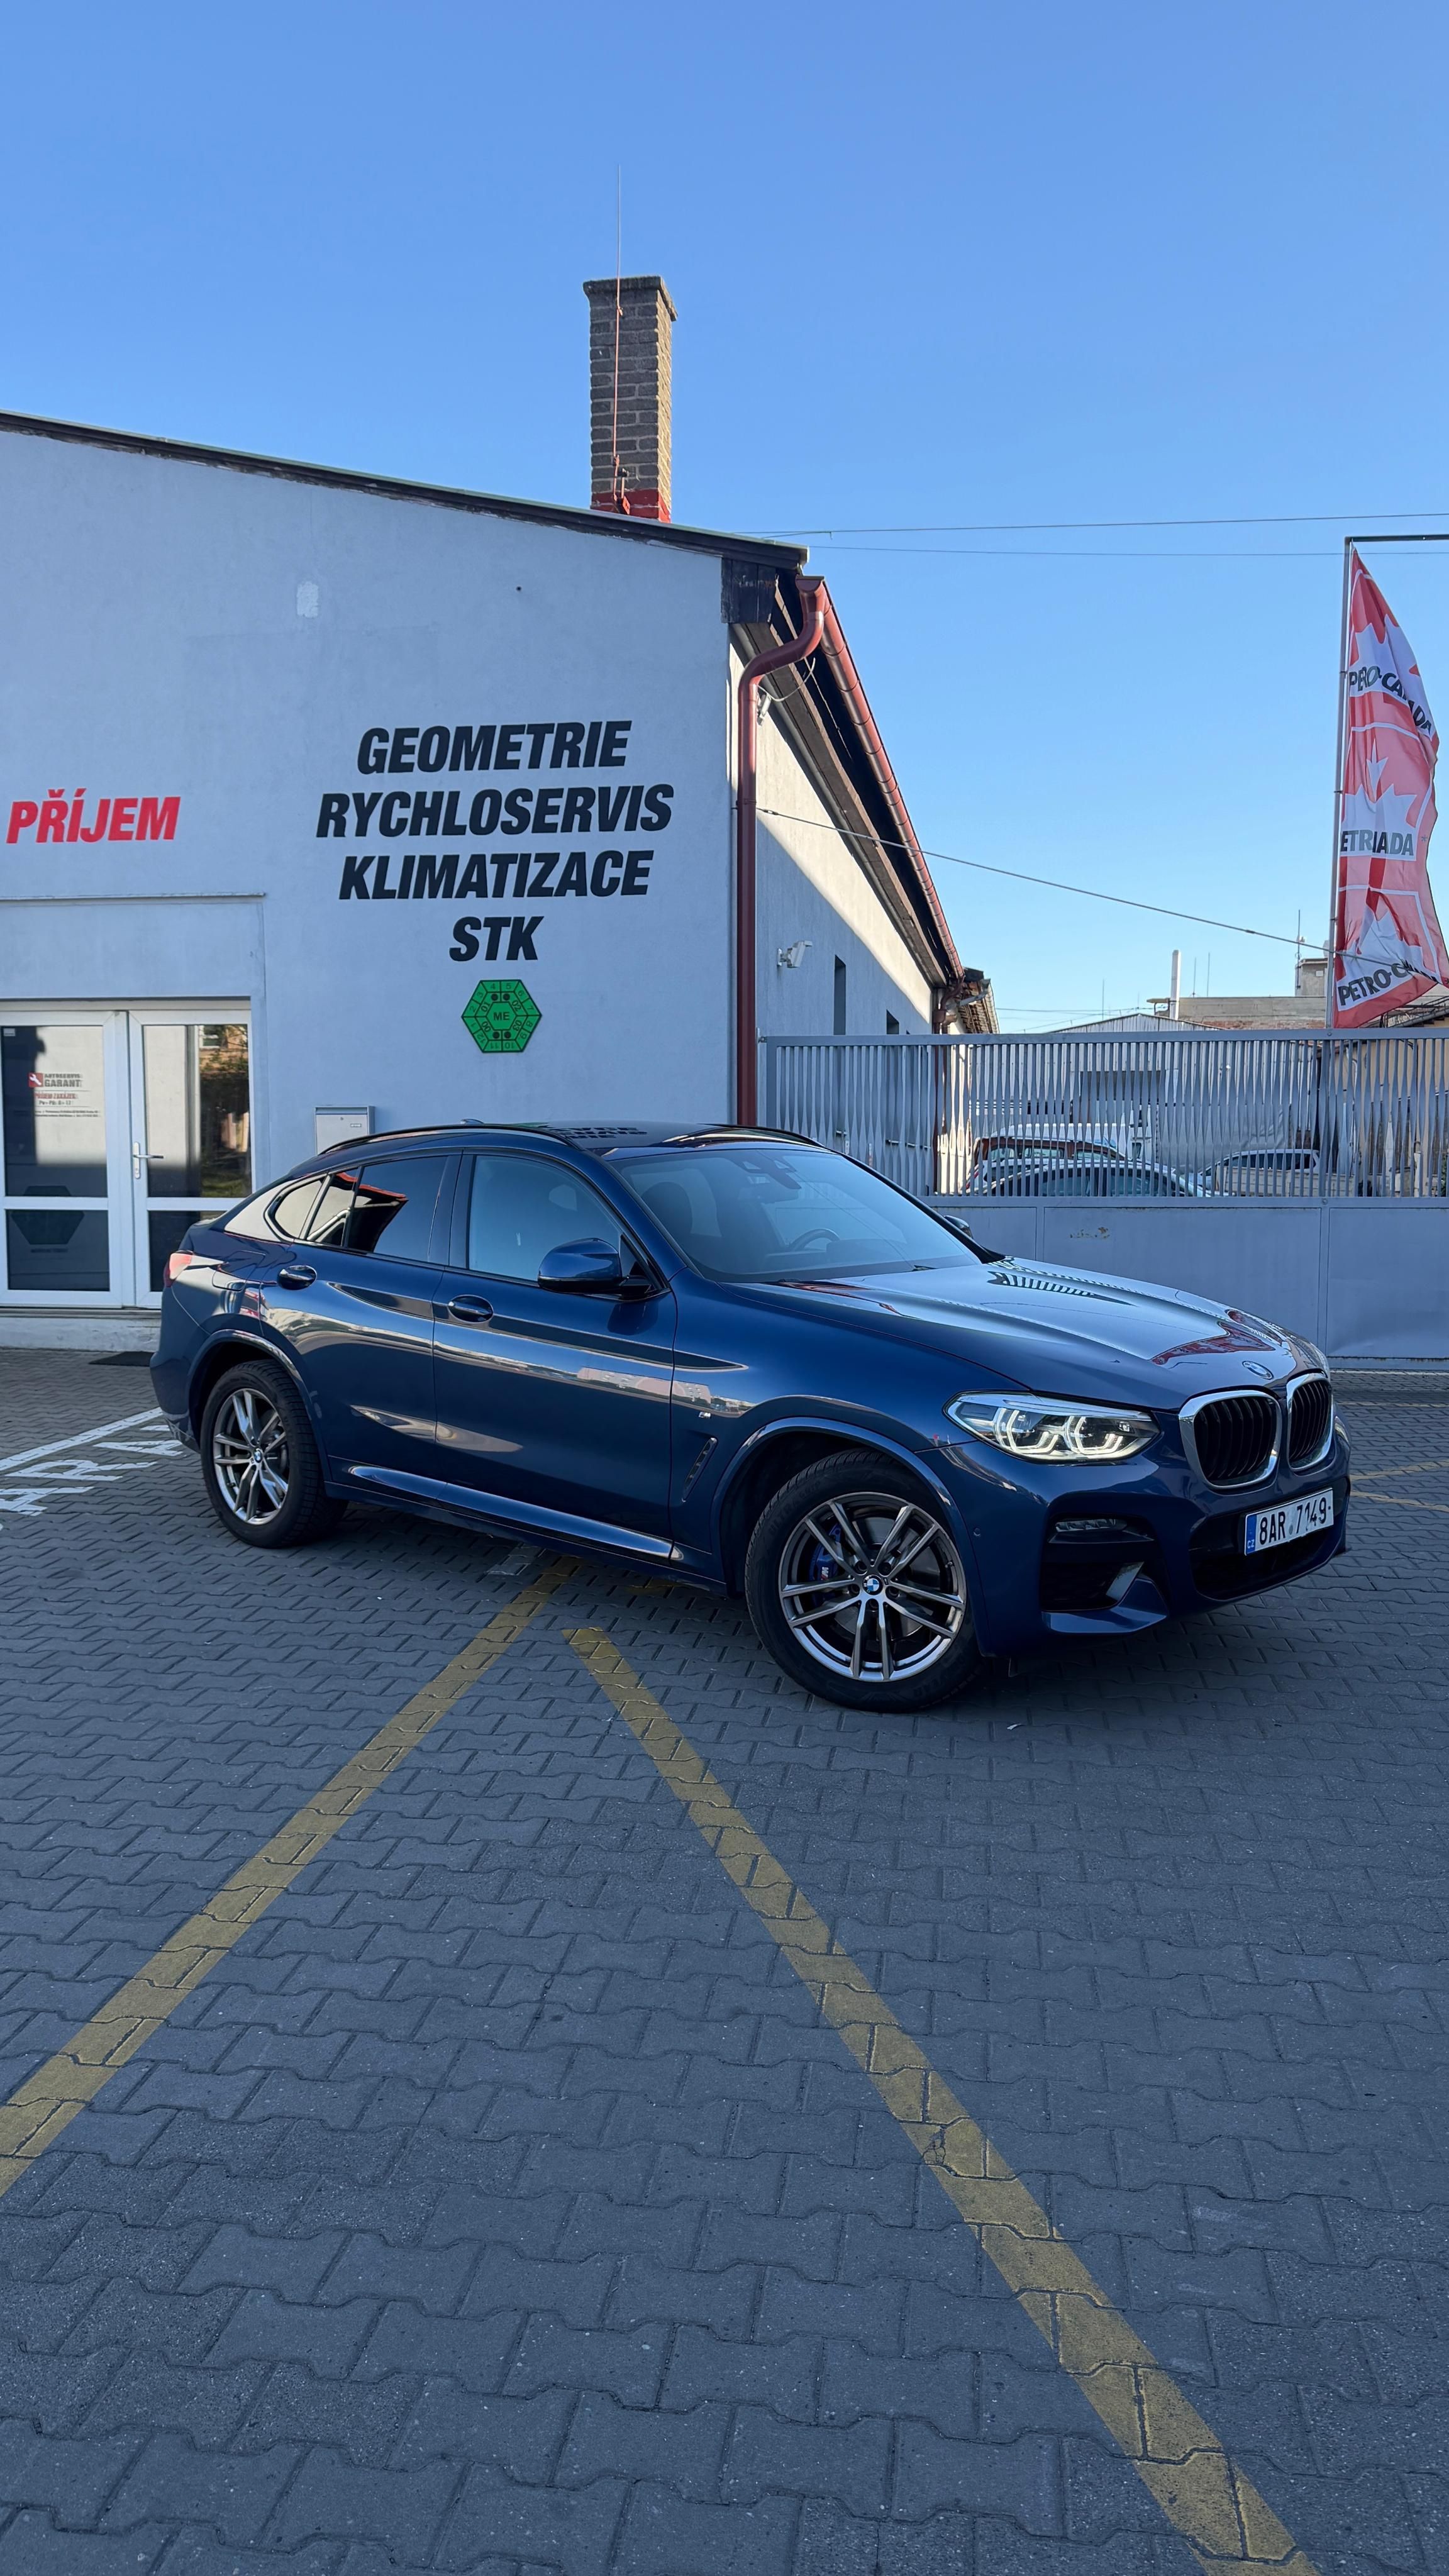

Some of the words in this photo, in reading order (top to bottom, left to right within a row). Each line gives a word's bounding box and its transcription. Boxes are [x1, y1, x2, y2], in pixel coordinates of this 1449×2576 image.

[358, 721, 632, 774] GEOMETRIE
[6, 787, 181, 843] PŘÍJEM
[316, 784, 674, 837] RYCHLOSERVIS
[339, 850, 654, 899] KLIMATIZACE
[450, 916, 544, 961] STK
[493, 1012, 510, 1021] ME
[512, 1000, 521, 1011] 02
[1247, 1539, 1255, 1549] CZ
[1260, 1511, 1286, 1545] 8AR
[1296, 1497, 1326, 1533] 7149
